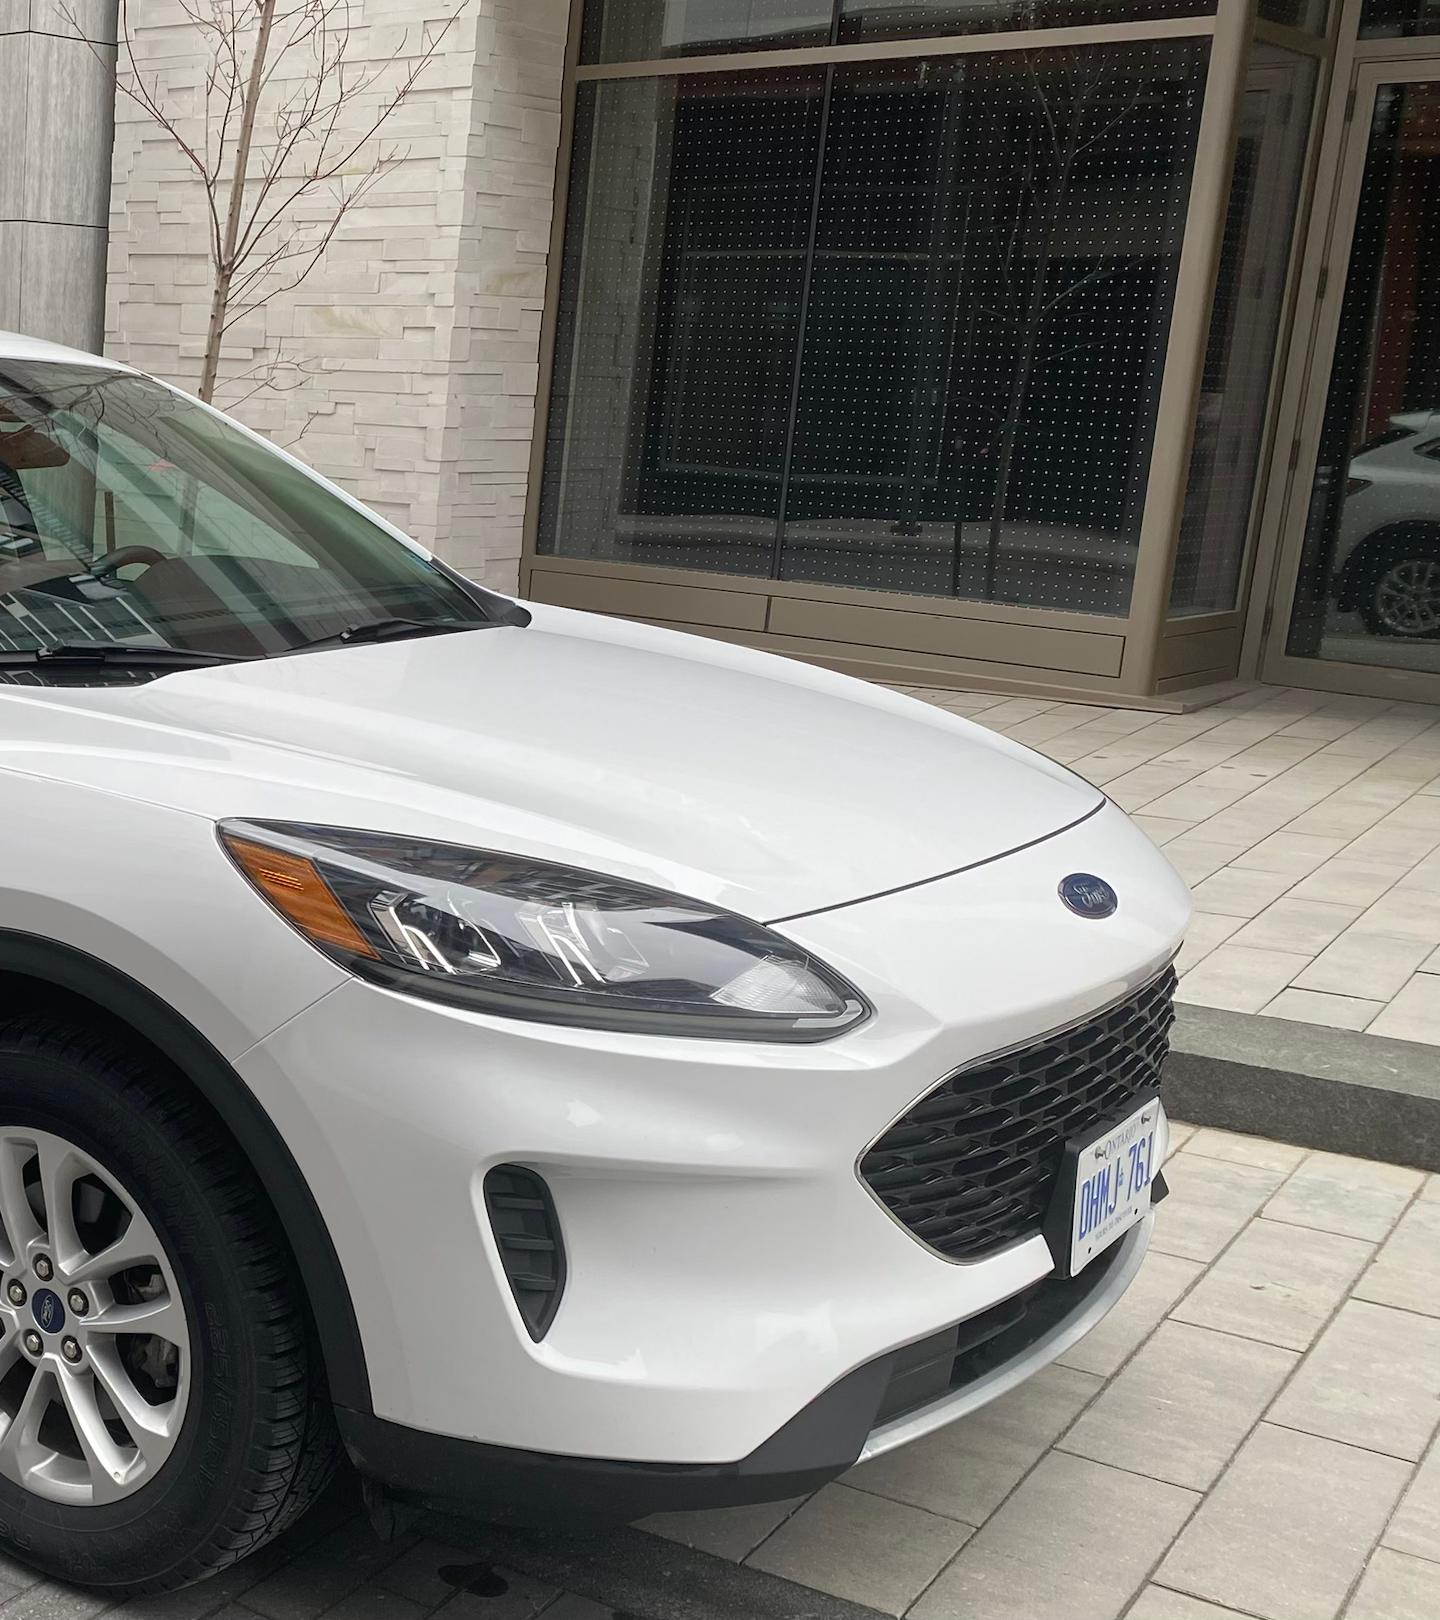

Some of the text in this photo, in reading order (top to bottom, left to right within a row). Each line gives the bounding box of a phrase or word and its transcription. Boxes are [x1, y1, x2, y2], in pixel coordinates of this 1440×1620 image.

[1072, 881, 1109, 908] Ford
[1105, 1124, 1137, 1160] ONTARIO
[1078, 1156, 1121, 1242] DHMJ
[1127, 1131, 1154, 1202] 761
